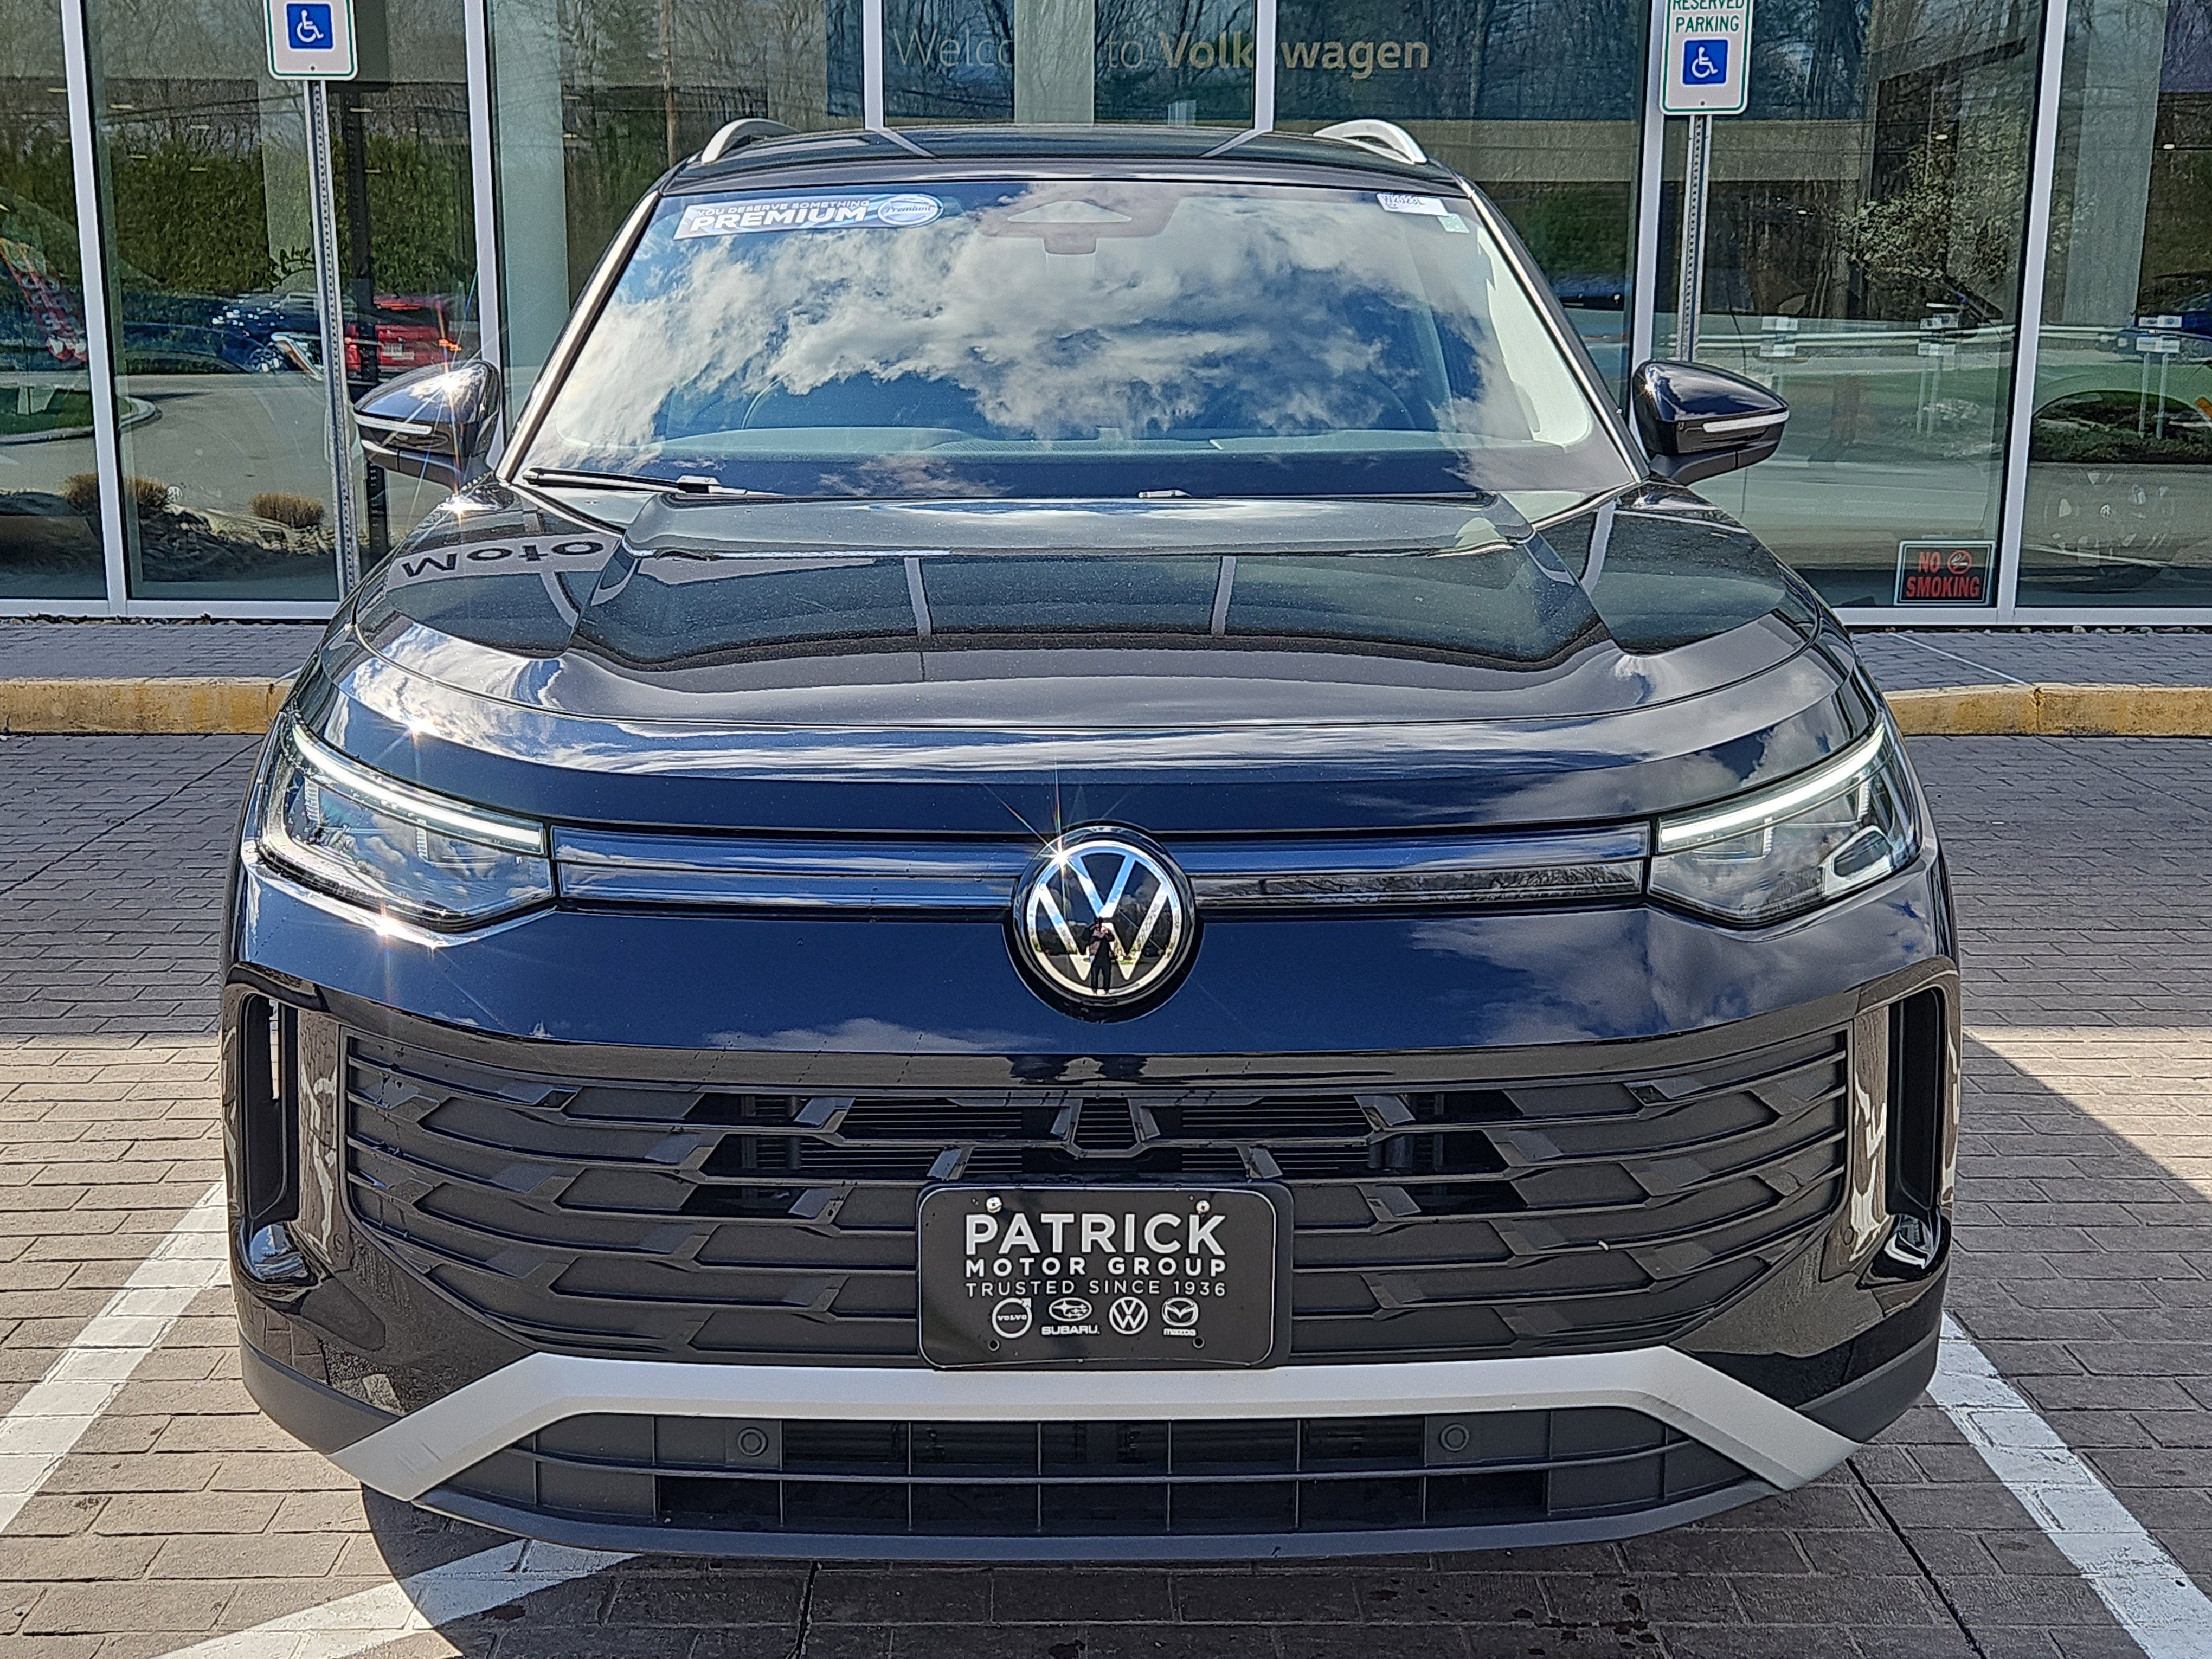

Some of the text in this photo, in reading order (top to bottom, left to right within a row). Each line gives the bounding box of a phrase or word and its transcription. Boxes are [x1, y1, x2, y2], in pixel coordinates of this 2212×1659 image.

[1673, 0, 1744, 10] RESERVED
[1675, 15, 1739, 33] PARKING
[1108, 35, 1144, 69] to
[1158, 31, 1429, 79] Volkwagen
[697, 200, 870, 216] YOU DESERVE SOMETHING
[690, 207, 869, 232] PREMIUM
[1918, 551, 1942, 573] NO
[1906, 576, 1980, 597] SMOKING
[966, 1213, 1226, 1255] PATRICK
[966, 1257, 1226, 1277] MOTOR GROUP
[965, 1279, 1225, 1297] TRUSTED SINCE 1936
